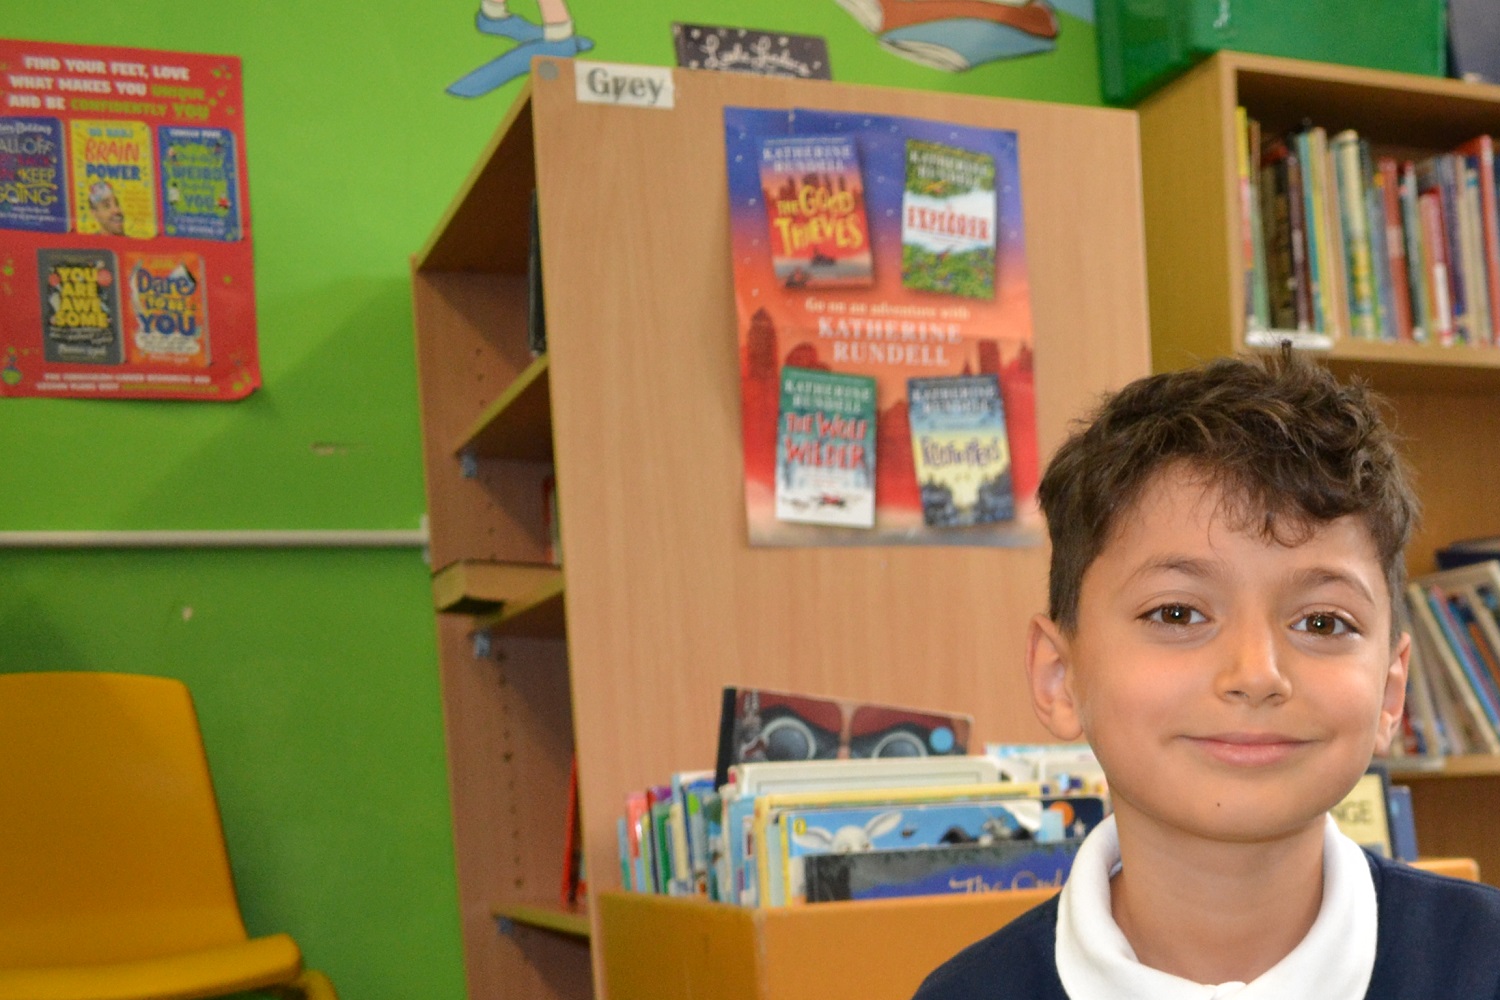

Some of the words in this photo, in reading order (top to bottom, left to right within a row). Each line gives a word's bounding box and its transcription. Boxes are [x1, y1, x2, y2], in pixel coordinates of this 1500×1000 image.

[24, 55, 60, 71] FIND
[64, 58, 107, 74] YOUR
[110, 62, 149, 79] FEET,
[153, 65, 190, 81] LOVE
[8, 75, 53, 90] WHAT
[58, 79, 112, 94] MAKES
[116, 81, 147, 96] YOU
[587, 67, 664, 104] Grey
[9, 95, 41, 108] AND
[45, 97, 65, 110] BE
[172, 103, 209, 120] YOU
[86, 138, 139, 163] BRAIN
[86, 164, 141, 180] POWER
[799, 184, 856, 217] GOOD
[774, 214, 863, 257] THIEVES
[908, 205, 989, 241] EXPLORER
[56, 267, 98, 282] YOU
[137, 269, 196, 296] Dare
[61, 282, 97, 297] ARE
[54, 311, 108, 328] SOME
[869, 301, 937, 318] adventure
[139, 313, 196, 336] YOU
[818, 317, 962, 343] KATHERINE
[833, 341, 950, 366] RUNDELL
[784, 437, 864, 470] WILDER
